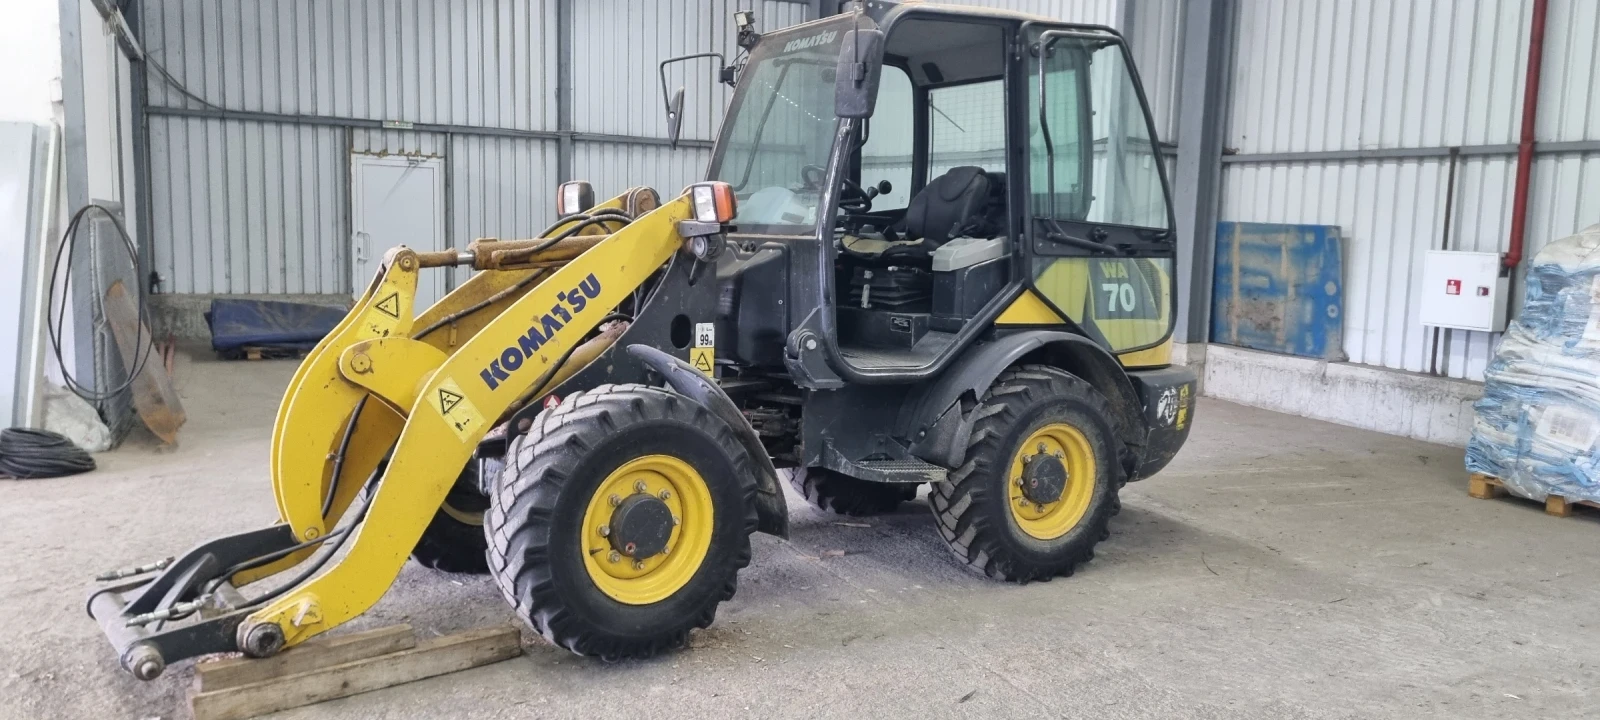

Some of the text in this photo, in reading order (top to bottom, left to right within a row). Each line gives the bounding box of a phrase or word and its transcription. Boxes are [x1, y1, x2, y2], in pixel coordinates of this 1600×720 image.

[783, 30, 838, 52] KOMATSU
[1099, 261, 1128, 278] WA
[1101, 282, 1136, 312] 70
[479, 272, 602, 391] KOMATSU
[700, 334, 709, 346] 99
